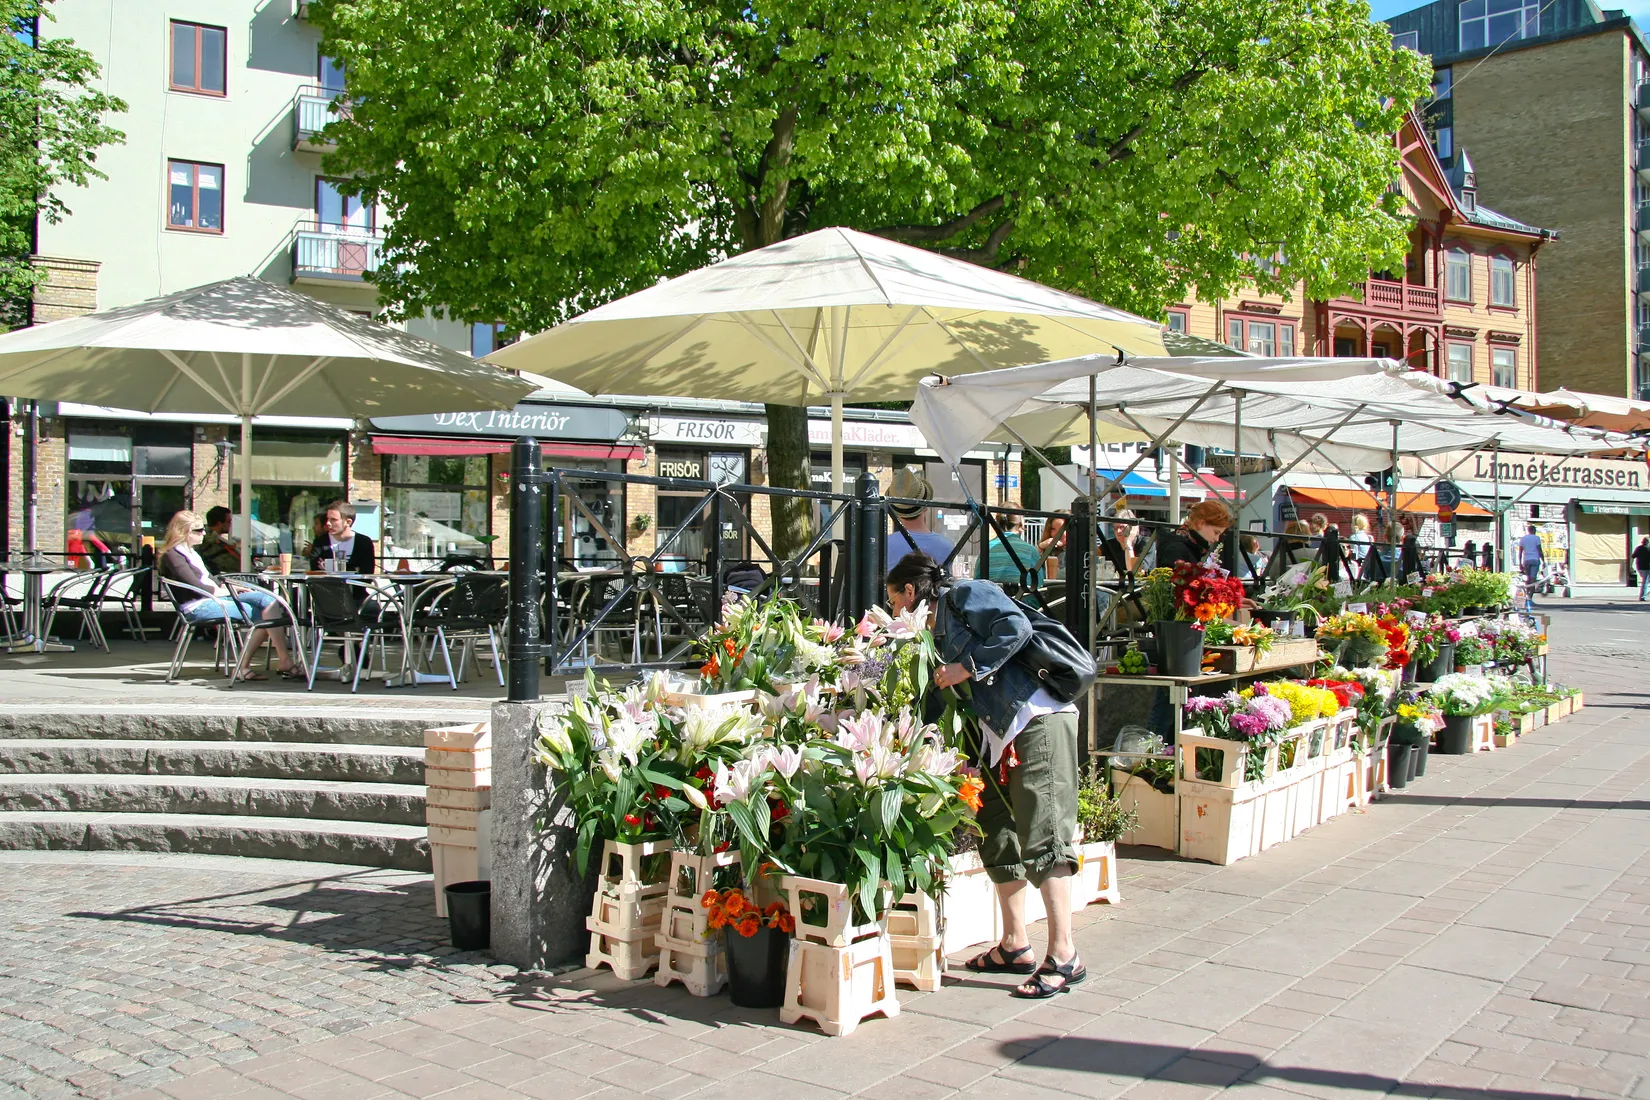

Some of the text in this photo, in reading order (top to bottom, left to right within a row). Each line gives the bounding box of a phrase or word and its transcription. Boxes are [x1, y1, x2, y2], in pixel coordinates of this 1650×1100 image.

[434, 410, 570, 432] Dex Interiör
[676, 420, 736, 440] FRISÖR
[808, 426, 900, 443] amaKläder.
[660, 461, 701, 478] FRISÖR
[1474, 454, 1640, 488] Linnéterrassen
[722, 529, 738, 540] ISÖR
